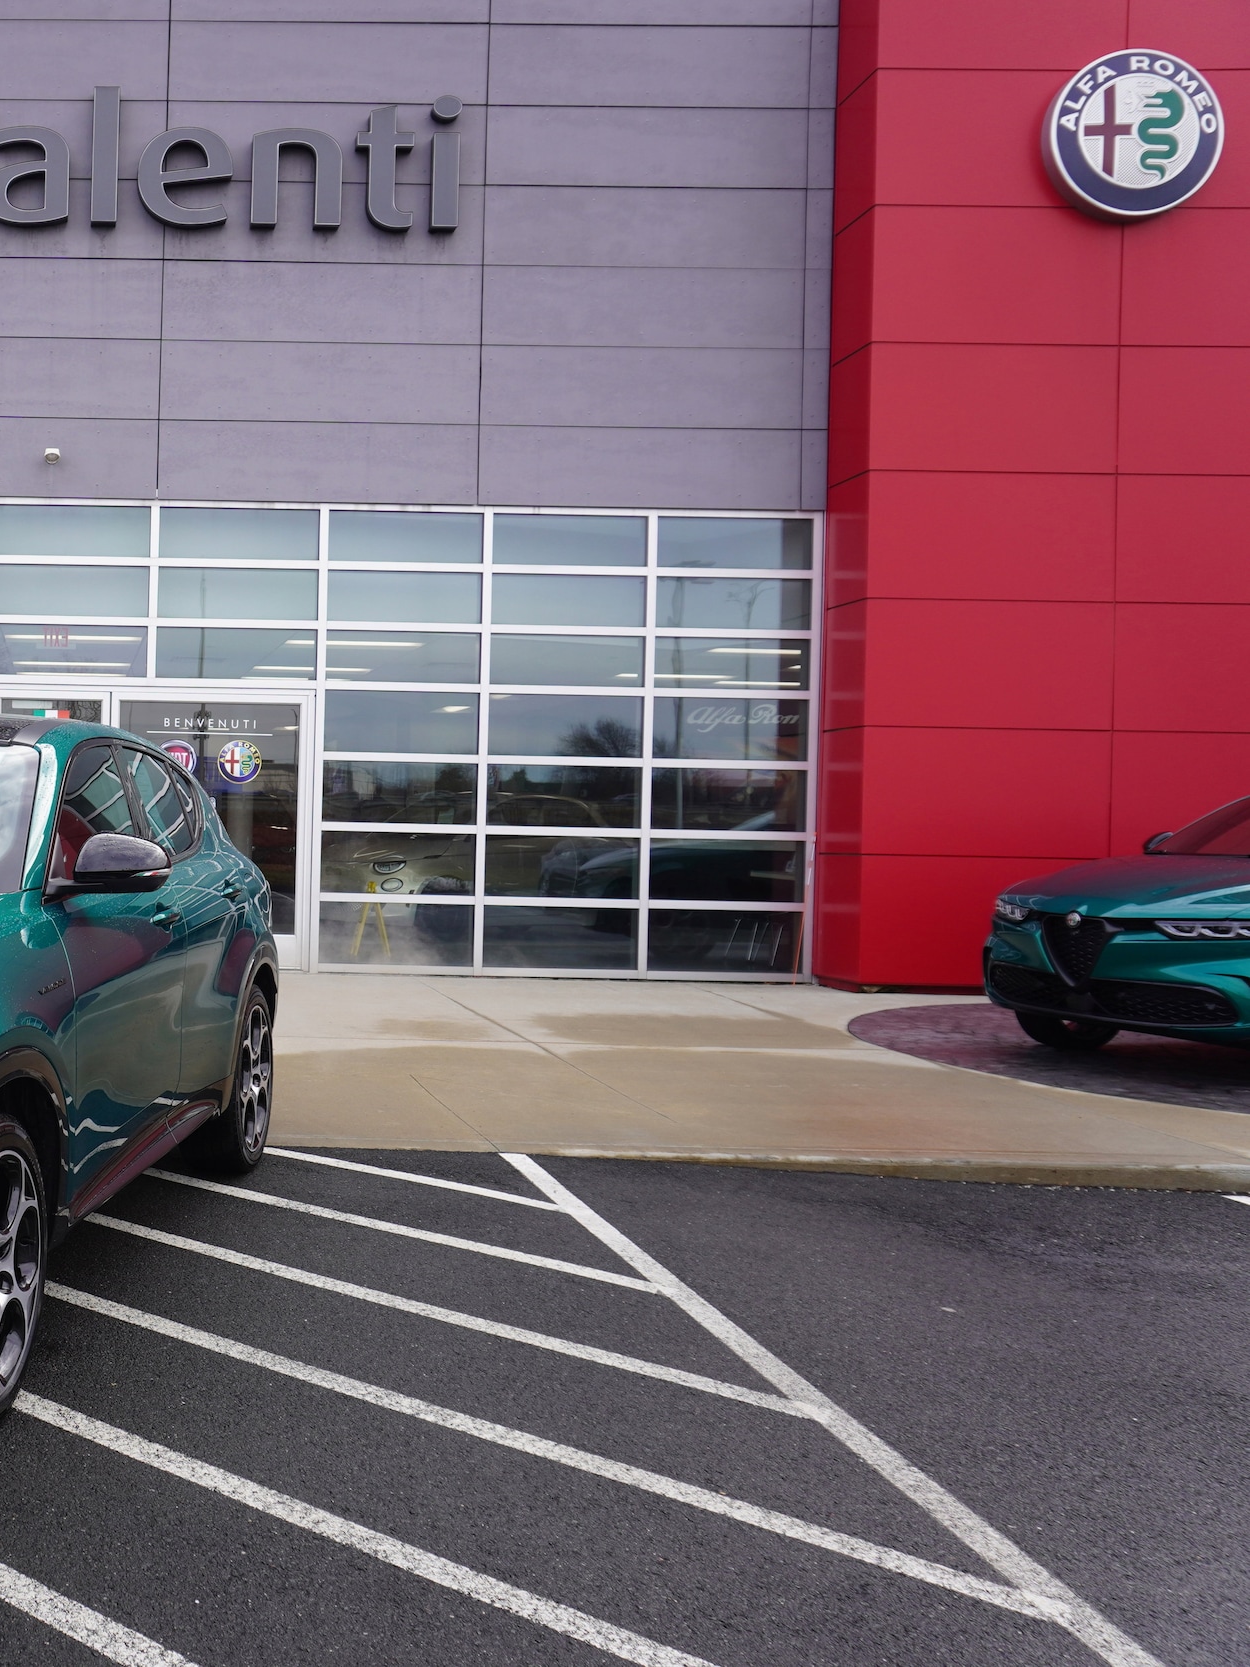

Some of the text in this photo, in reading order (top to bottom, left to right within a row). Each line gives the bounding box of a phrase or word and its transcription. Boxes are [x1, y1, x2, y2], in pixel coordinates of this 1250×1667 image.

[1059, 56, 1217, 134] ALFA ROMEO
[163, 717, 257, 729] BENVENUTI
[687, 706, 746, 733] Alfa
[238, 742, 260, 764] ROMEO
